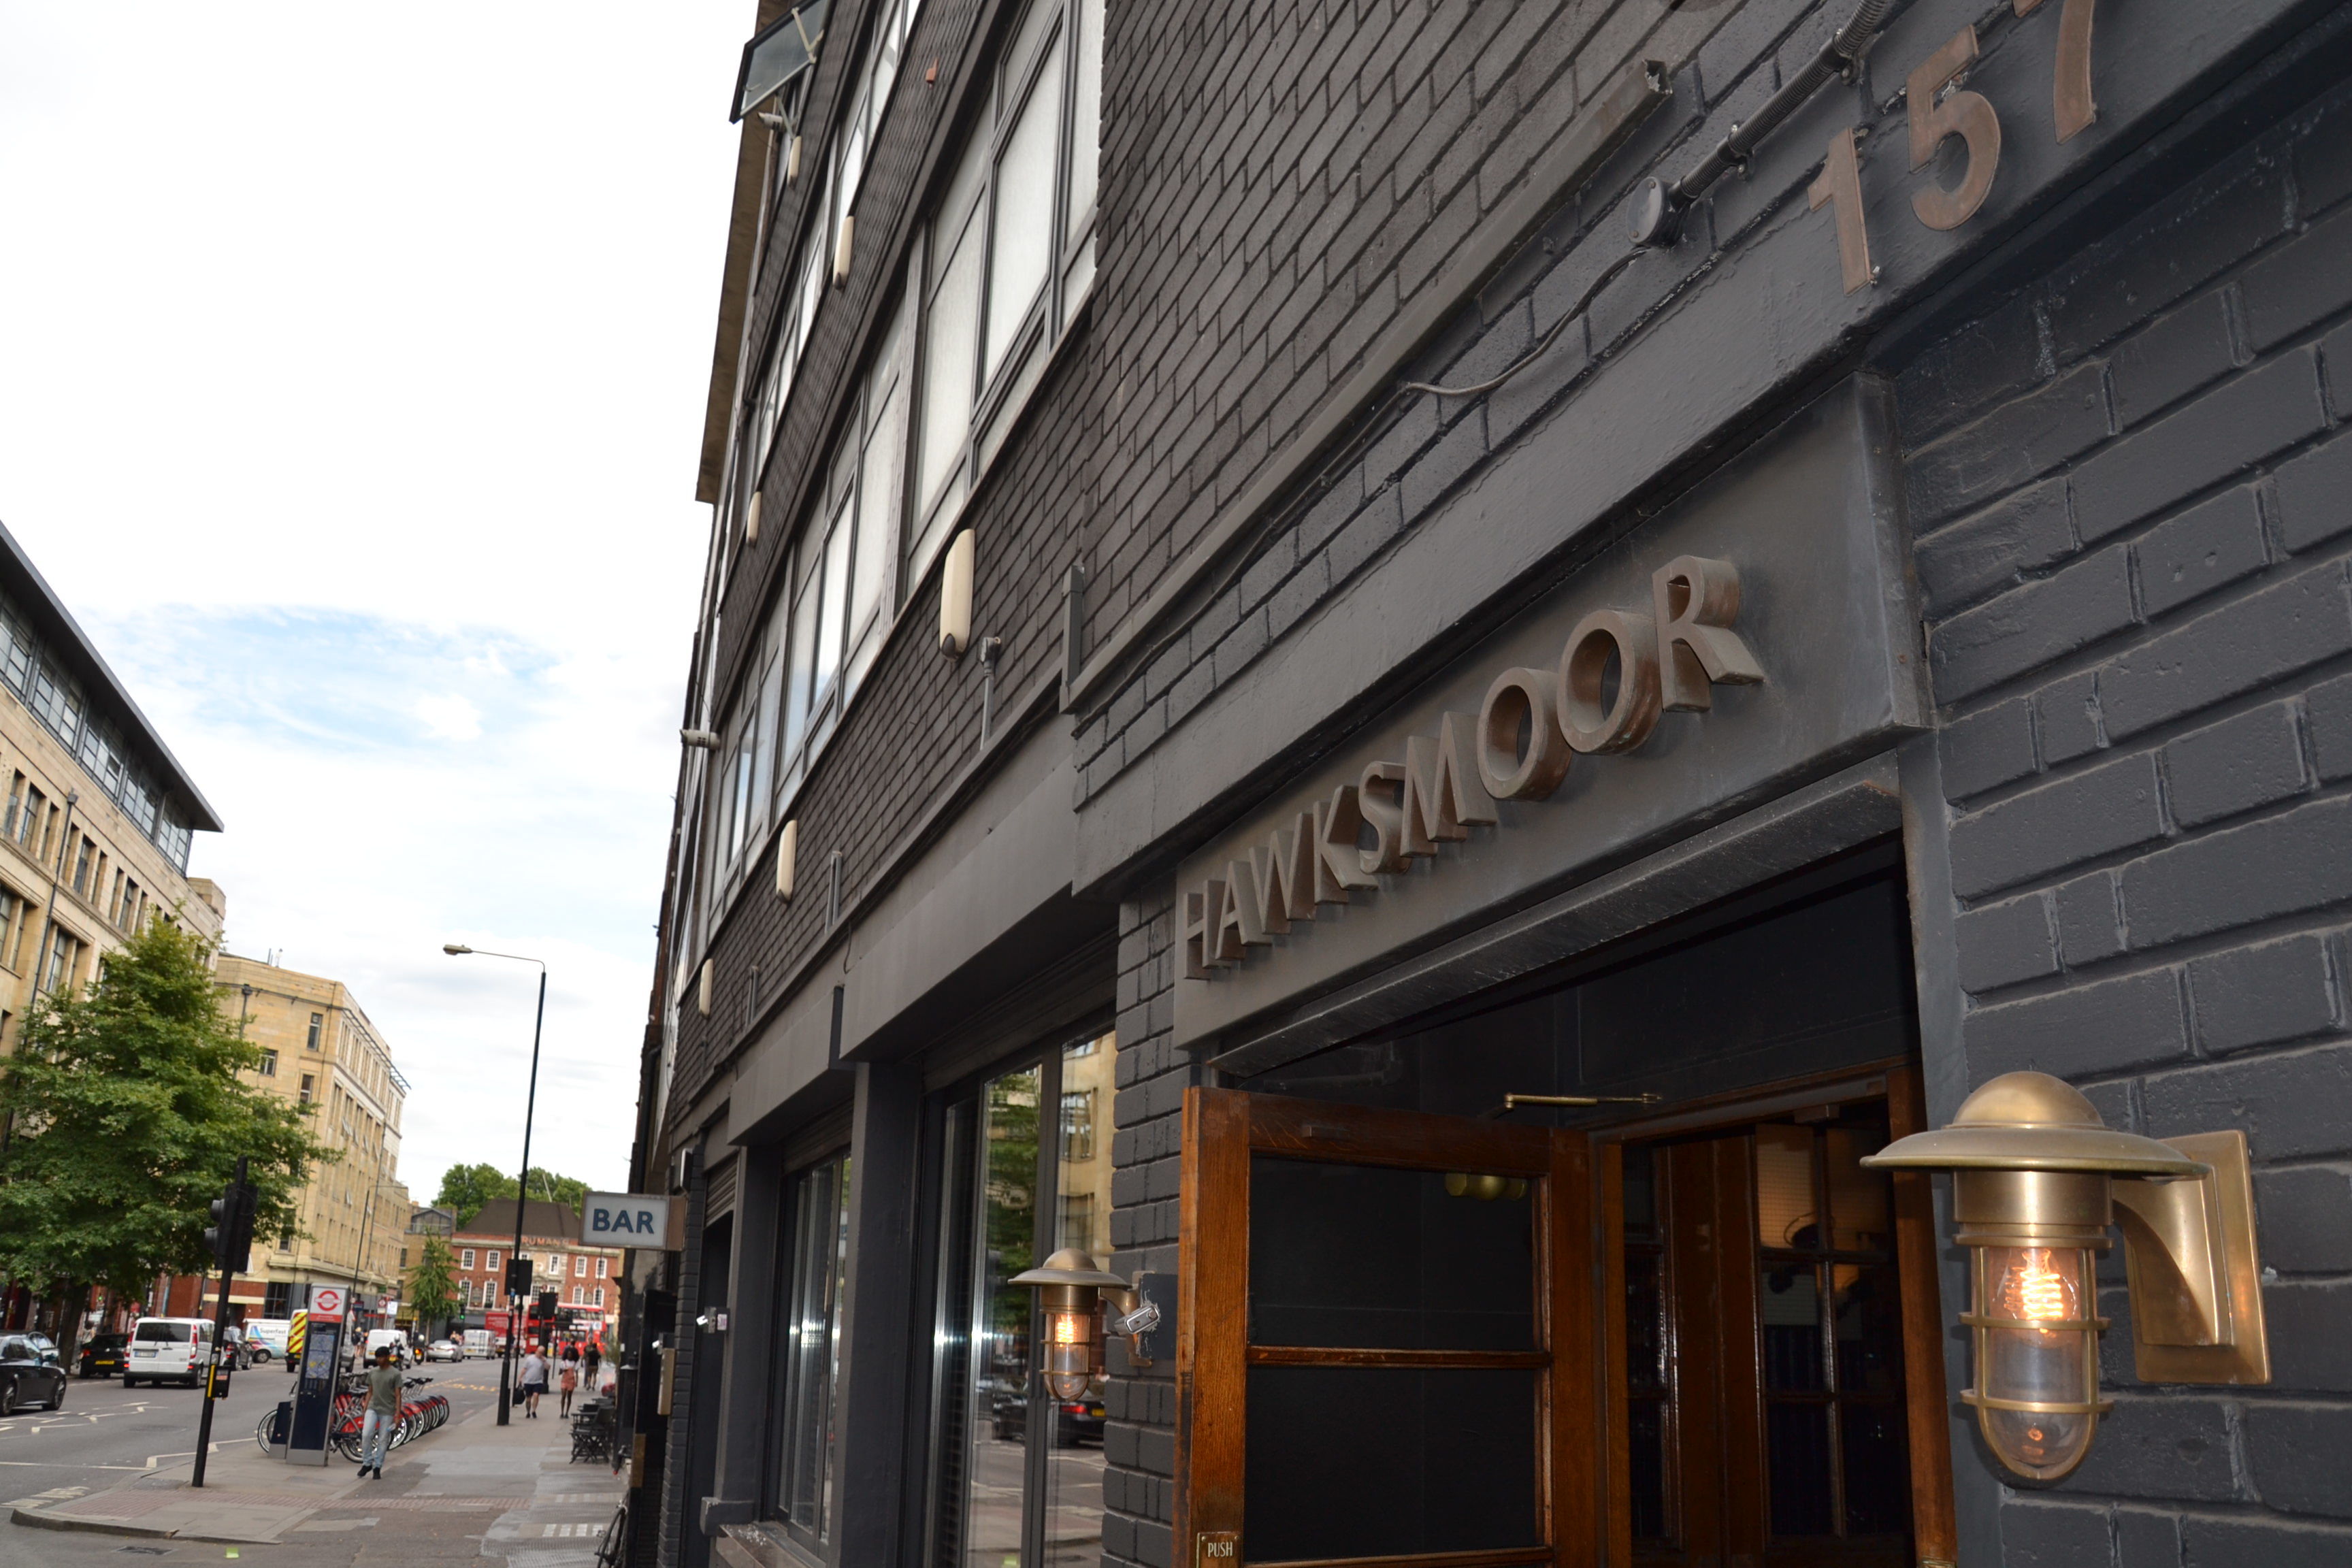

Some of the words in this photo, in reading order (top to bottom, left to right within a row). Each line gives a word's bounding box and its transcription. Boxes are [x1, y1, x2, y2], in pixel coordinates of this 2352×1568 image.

[1808, 0, 2098, 297] 157
[1183, 554, 1765, 980] HAWKSMOOR
[592, 1208, 655, 1234] BAR
[1207, 1541, 1233, 1558] PUSH
